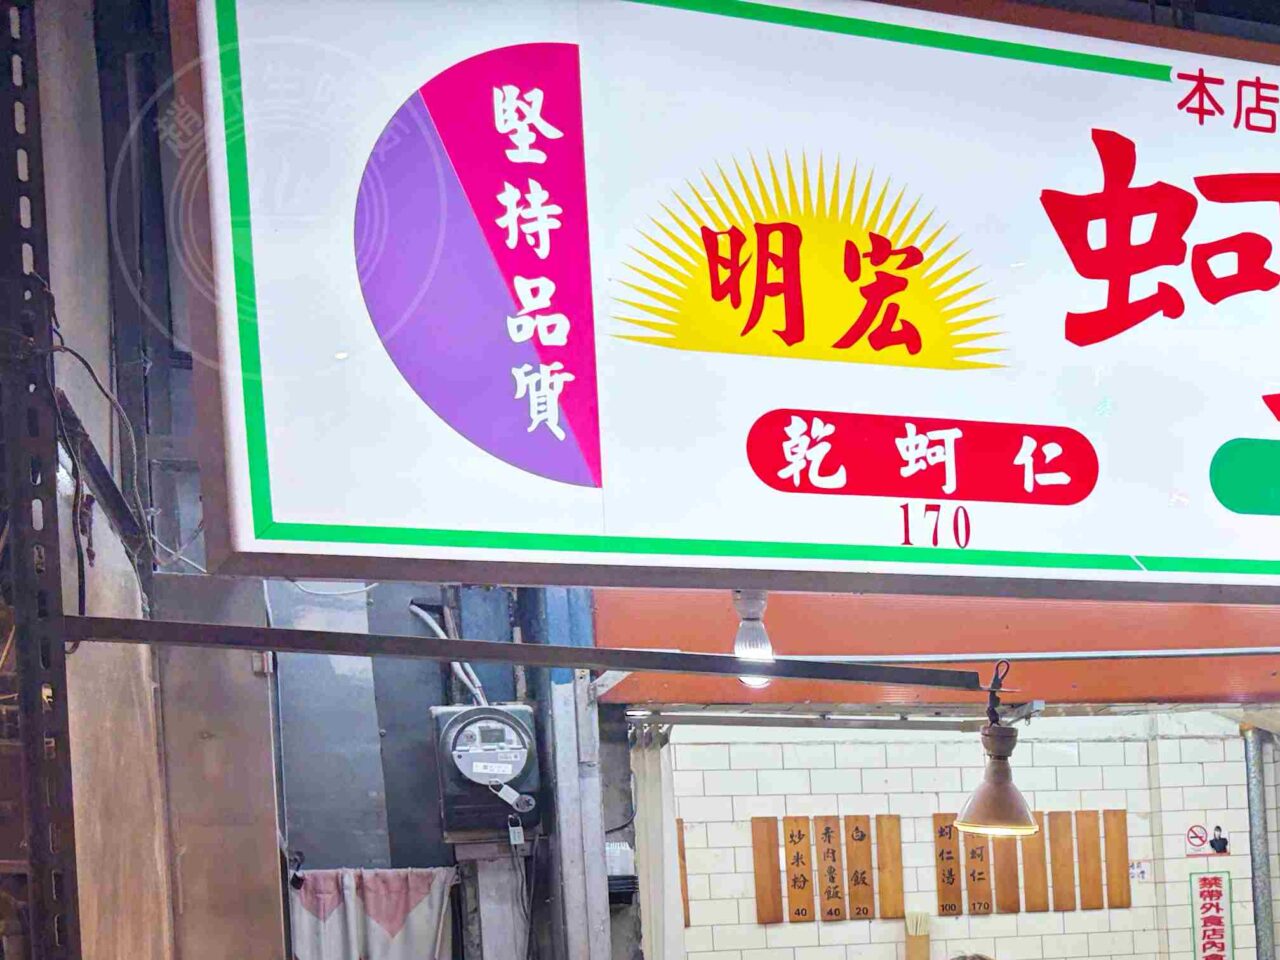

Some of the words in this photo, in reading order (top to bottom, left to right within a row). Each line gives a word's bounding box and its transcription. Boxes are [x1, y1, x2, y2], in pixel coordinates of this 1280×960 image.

[492, 84, 575, 441] 堅持品質
[700, 221, 925, 356] 明宏
[777, 416, 1072, 495] 乾蚵仁
[900, 503, 972, 550] 170
[788, 829, 809, 890] 炒米粉
[851, 826, 870, 886] 白飯
[794, 907, 807, 917] 40
[826, 907, 841, 917] 40
[855, 906, 869, 916] 20
[941, 903, 956, 912] 100
[971, 902, 990, 911] 170
